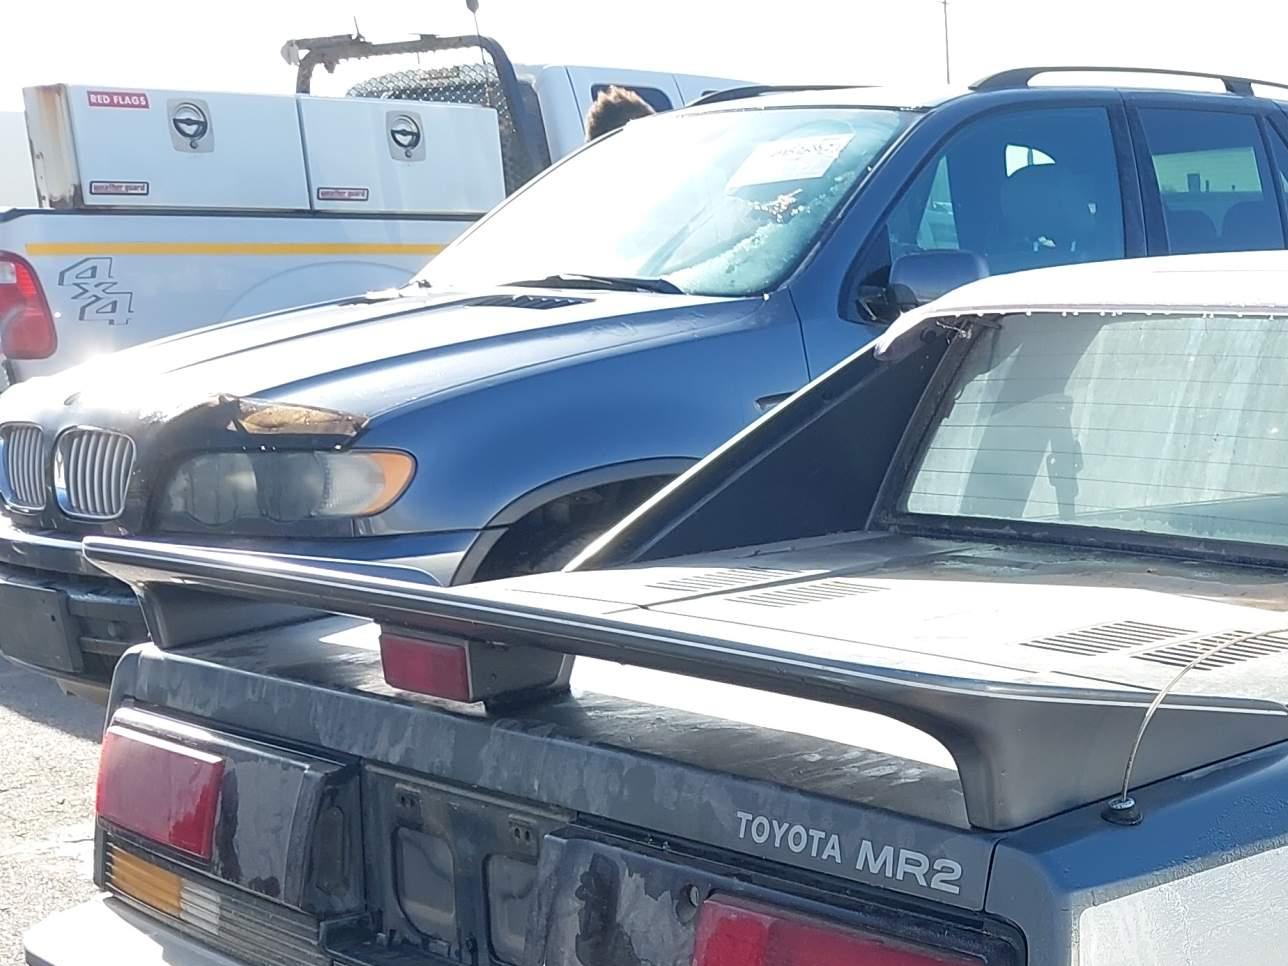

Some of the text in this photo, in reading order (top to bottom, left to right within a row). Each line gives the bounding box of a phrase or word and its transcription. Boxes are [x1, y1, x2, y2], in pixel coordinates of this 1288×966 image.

[90, 94, 147, 105] RED FLAGS
[736, 810, 963, 895] TOYOTA MR2
